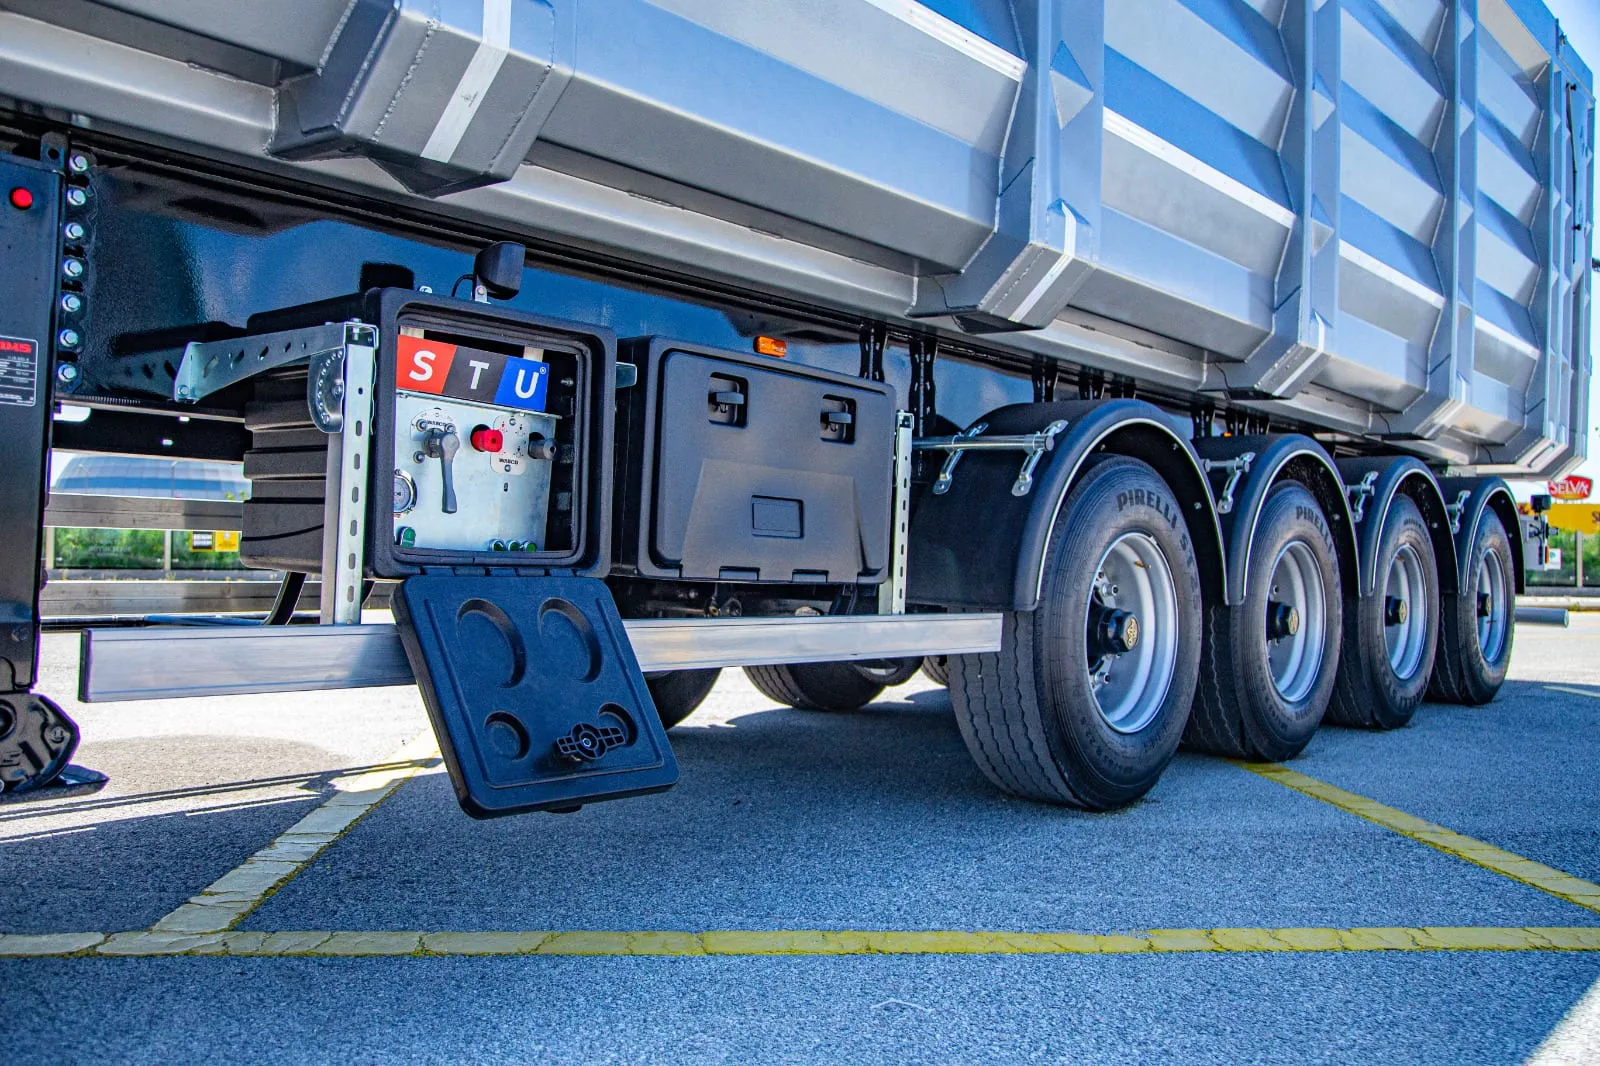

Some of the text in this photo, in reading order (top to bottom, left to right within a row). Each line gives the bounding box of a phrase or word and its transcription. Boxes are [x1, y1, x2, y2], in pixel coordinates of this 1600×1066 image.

[1116, 487, 1178, 529] PIRELLI
[1547, 479, 1589, 496] SELVA
[1296, 505, 1334, 553] PIRELLI
